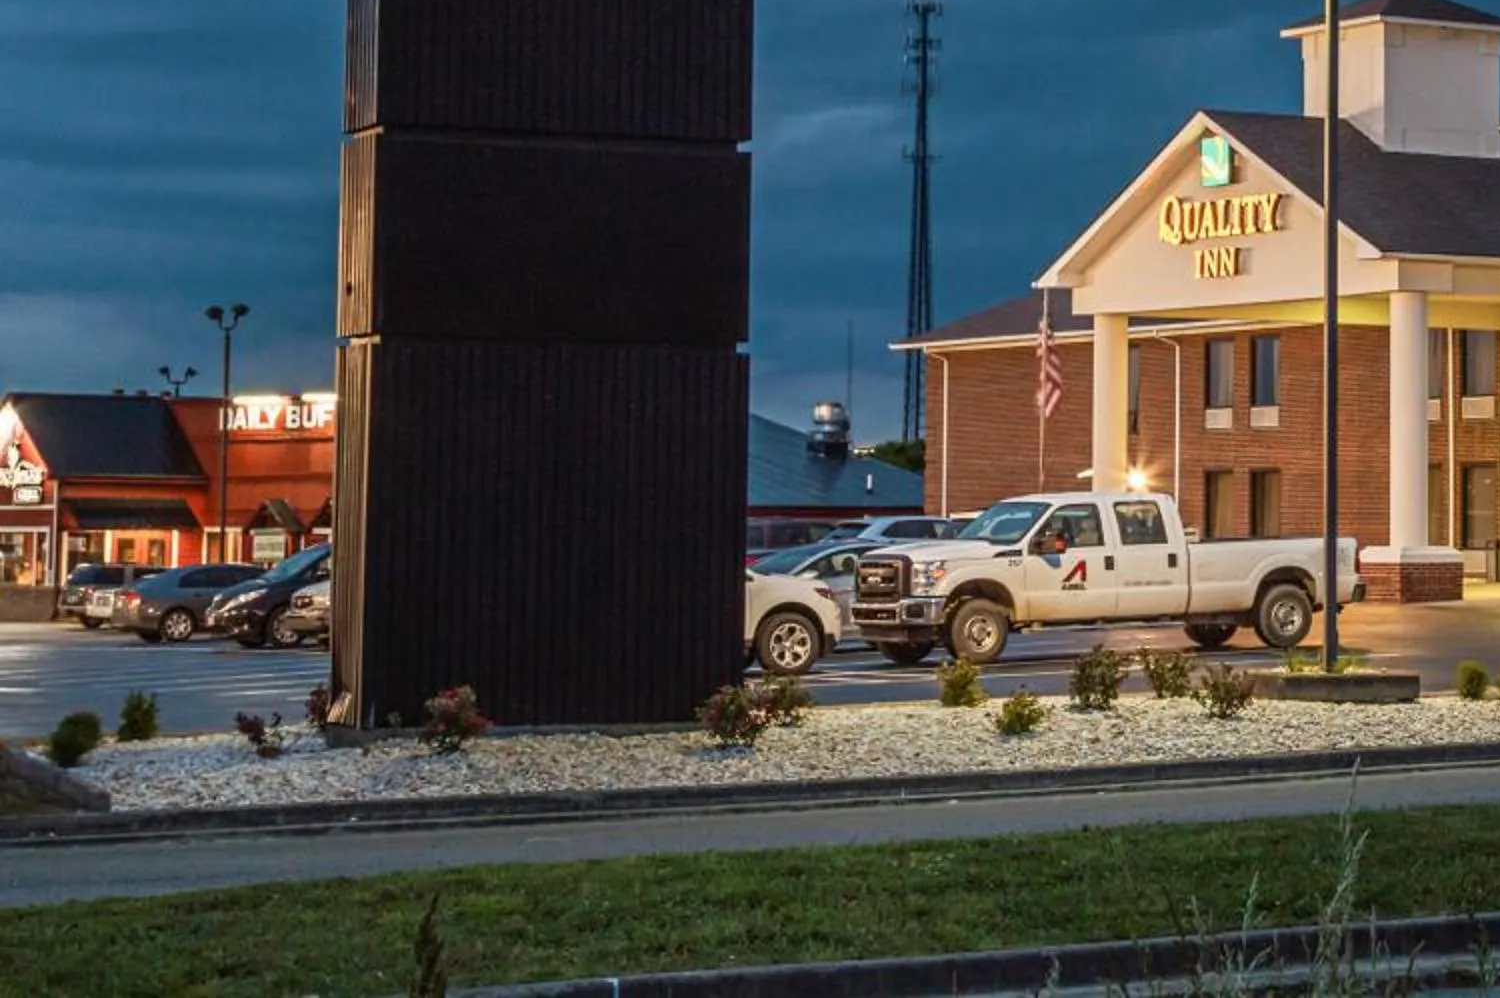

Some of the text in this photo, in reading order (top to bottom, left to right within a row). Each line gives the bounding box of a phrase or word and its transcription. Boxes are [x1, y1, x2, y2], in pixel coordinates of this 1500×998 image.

[1159, 193, 1280, 245] QUALITY
[1194, 246, 1240, 279] INN
[219, 405, 284, 431] DAILY
